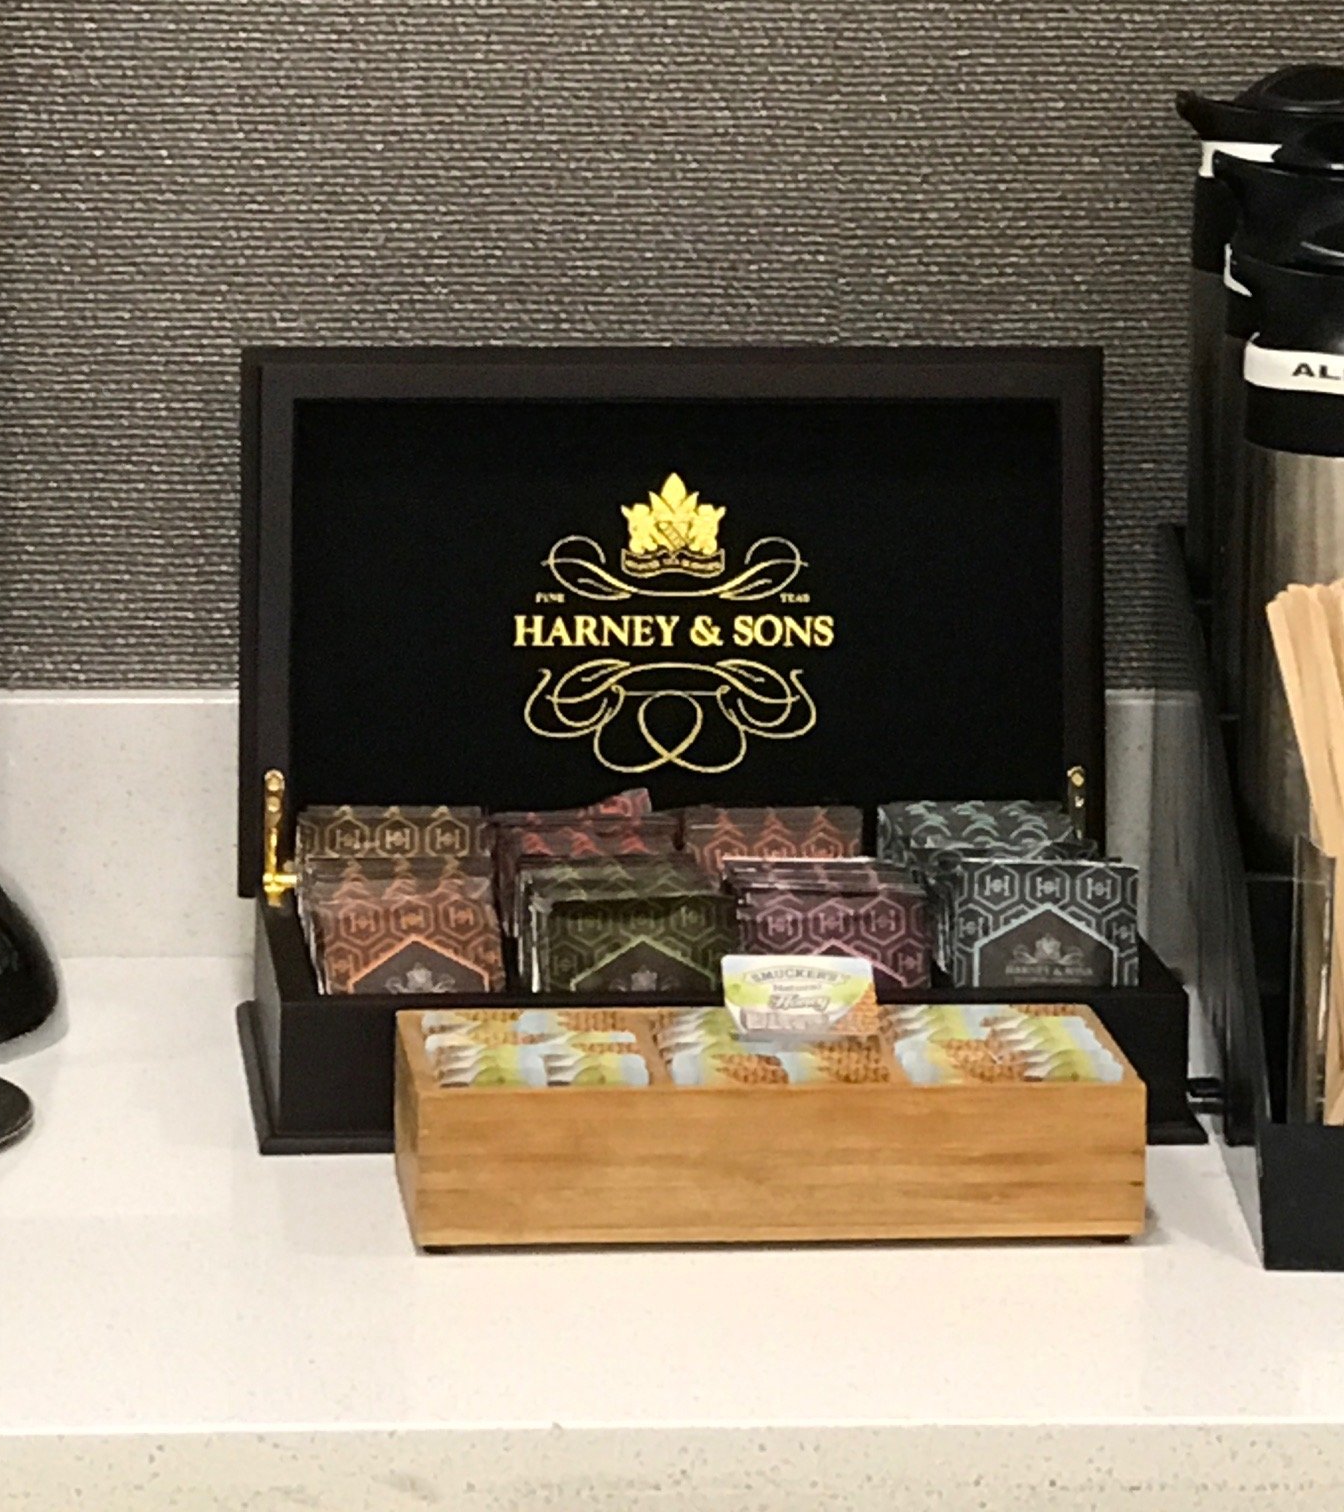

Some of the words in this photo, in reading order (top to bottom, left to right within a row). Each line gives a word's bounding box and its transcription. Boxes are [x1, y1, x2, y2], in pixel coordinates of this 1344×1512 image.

[780, 593, 810, 603] TEAS
[513, 615, 680, 647] HARNEY
[689, 615, 724, 647] &
[733, 614, 834, 647] SONS
